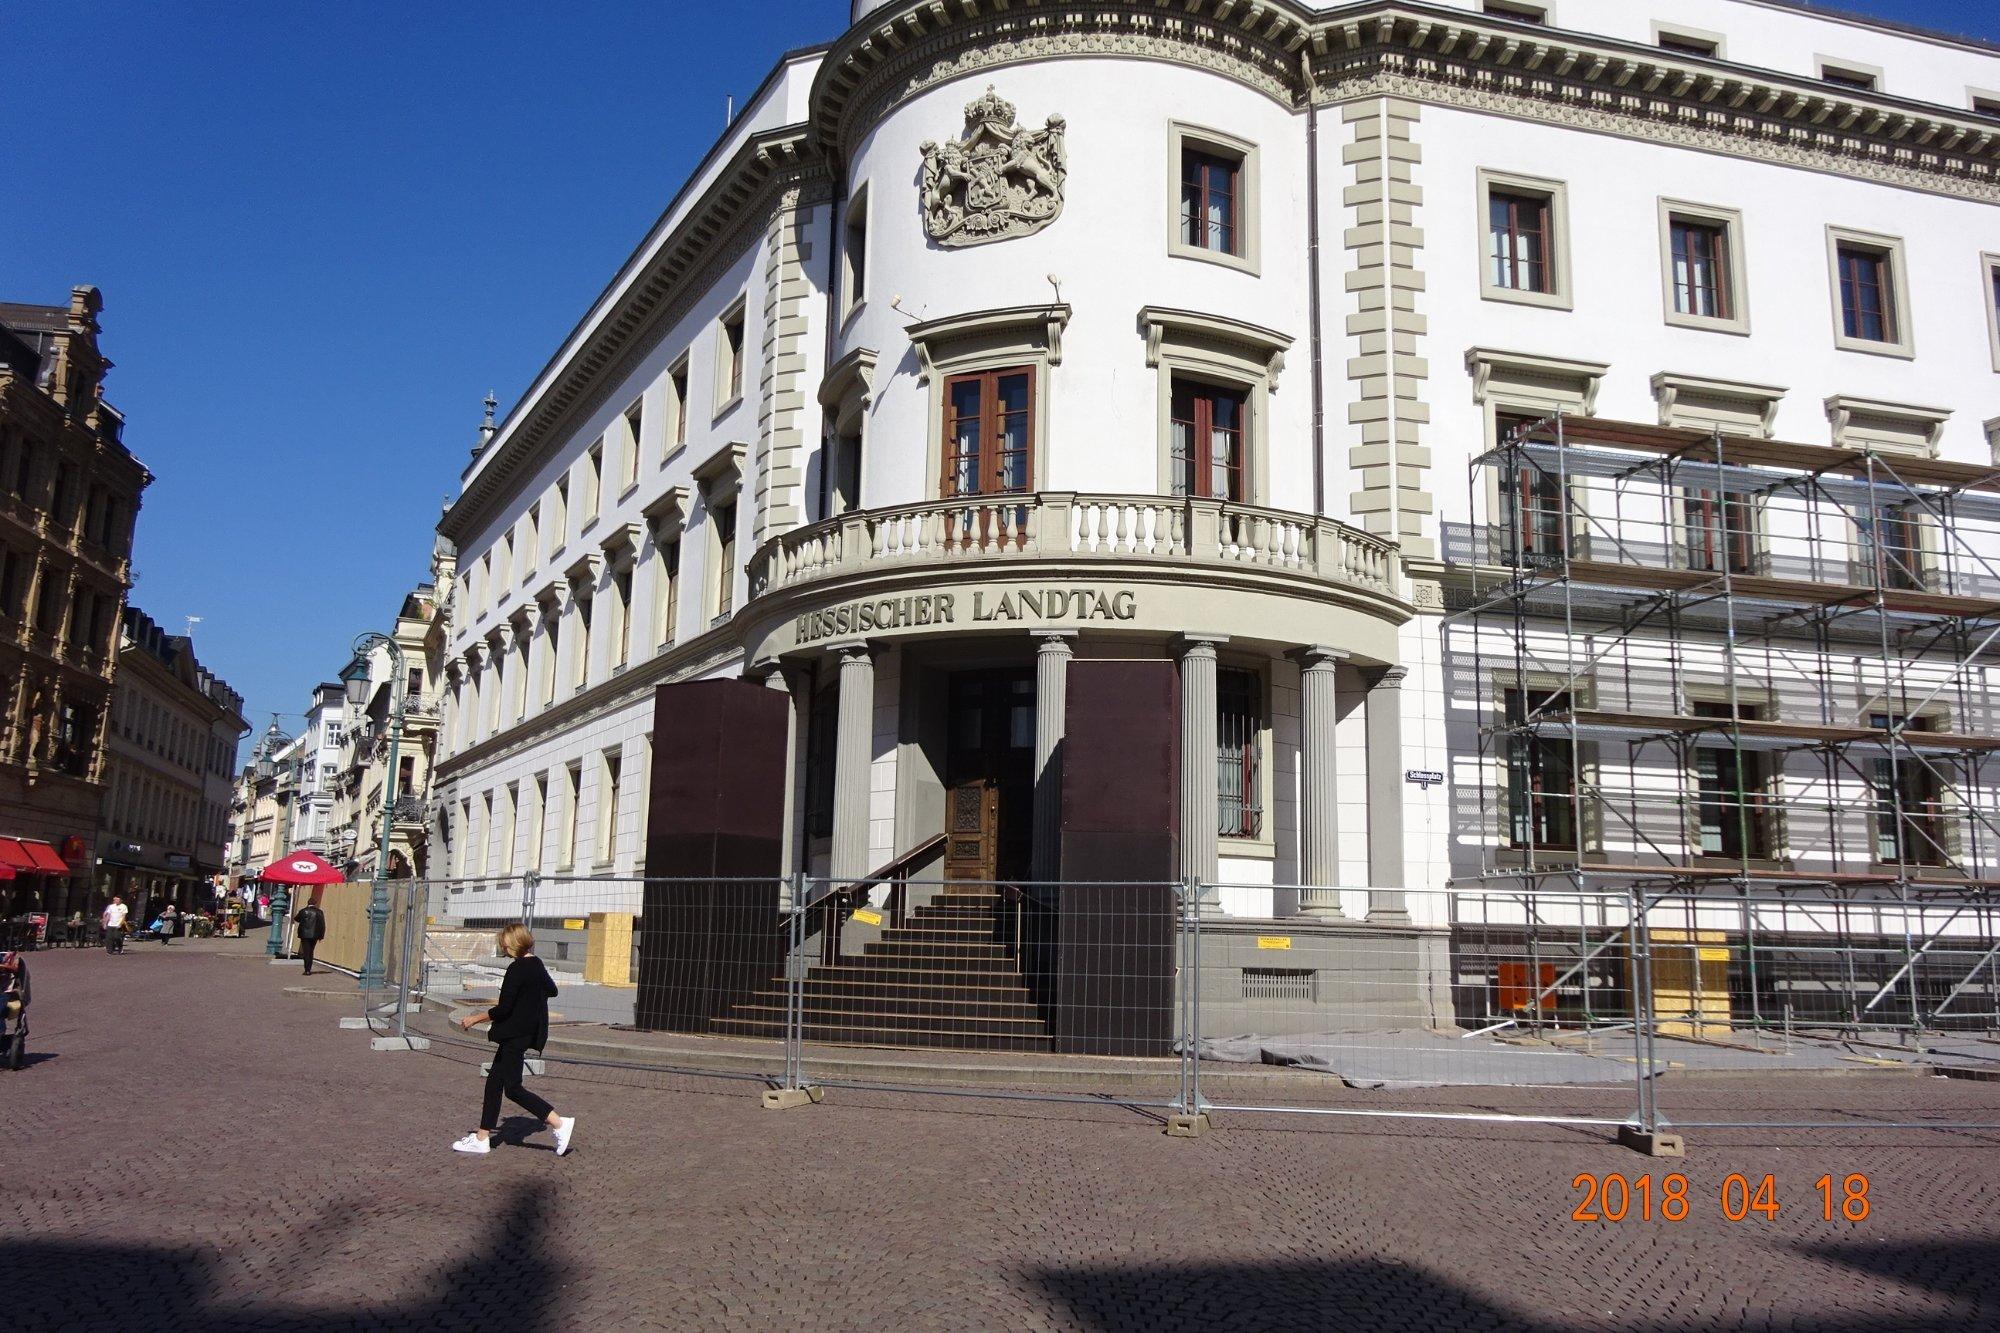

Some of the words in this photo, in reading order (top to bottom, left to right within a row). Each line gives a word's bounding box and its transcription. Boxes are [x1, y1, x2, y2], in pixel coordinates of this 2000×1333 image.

[795, 593, 955, 645] HESSISCHER
[972, 589, 1137, 622] LANDTAG
[1409, 771, 1442, 781] Schlossplatz
